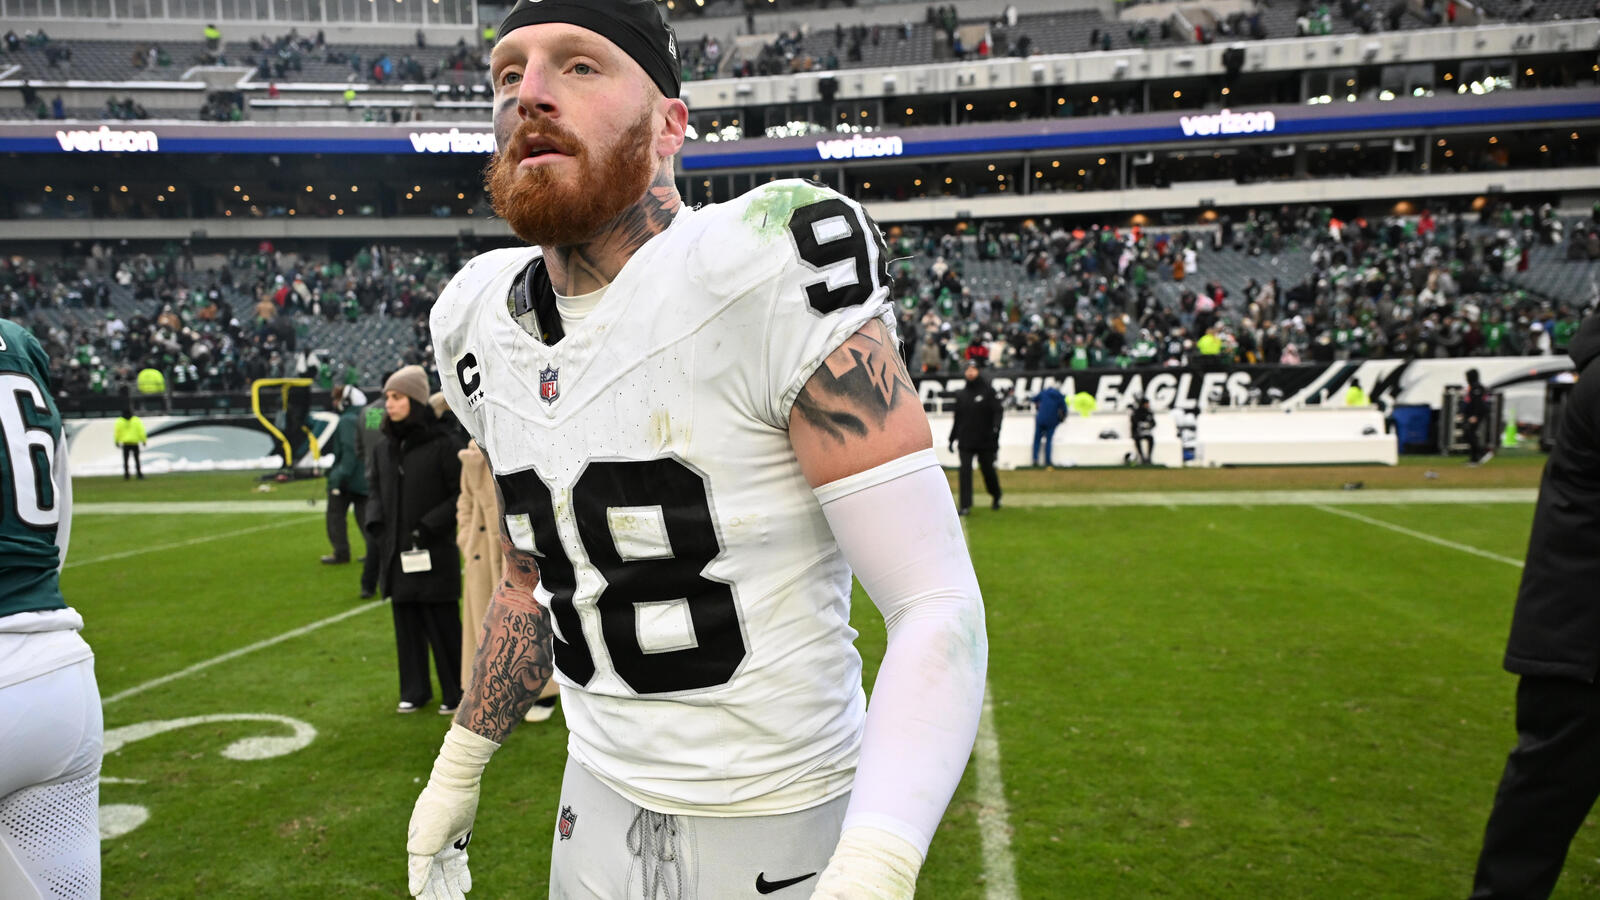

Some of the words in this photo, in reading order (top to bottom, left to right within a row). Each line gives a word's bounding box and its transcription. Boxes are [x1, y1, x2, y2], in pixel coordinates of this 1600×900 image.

[1180, 108, 1275, 136] verizon
[55, 125, 158, 152] verizon
[816, 133, 903, 160] verizon
[1095, 371, 1252, 411] EAGLES
